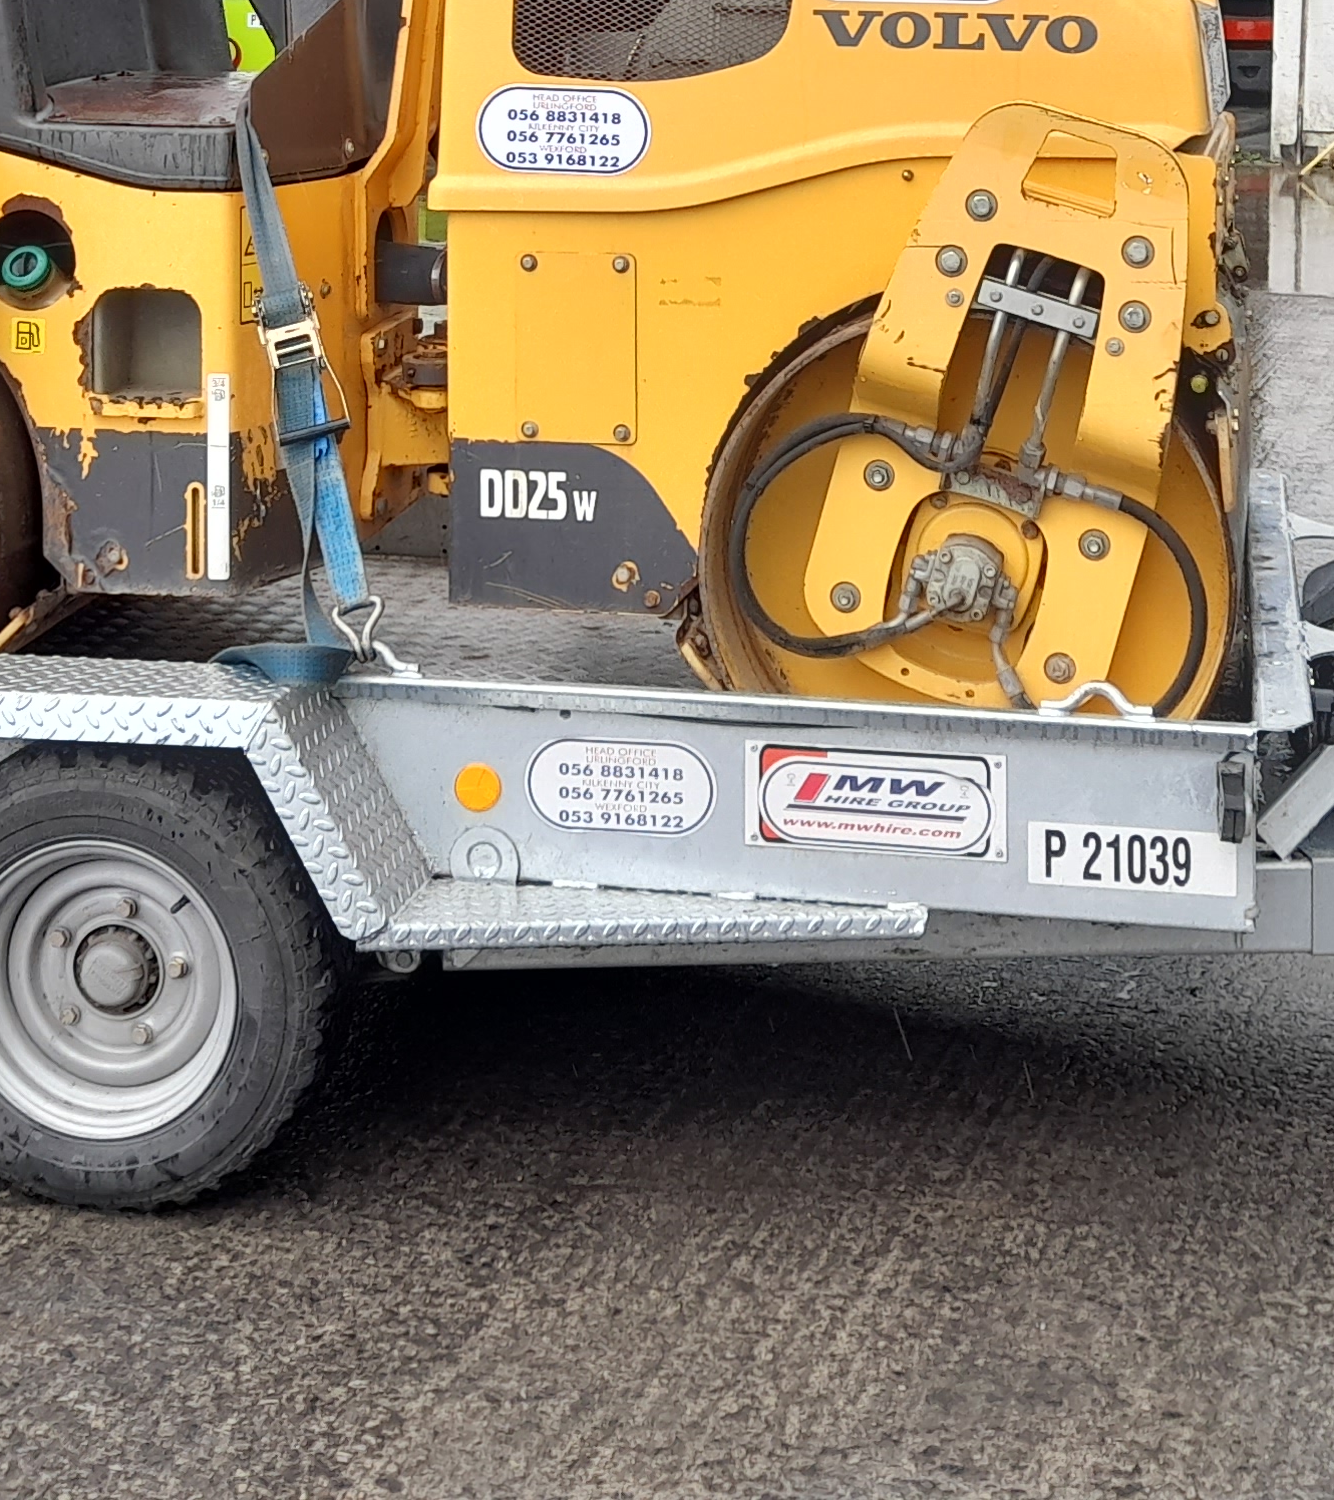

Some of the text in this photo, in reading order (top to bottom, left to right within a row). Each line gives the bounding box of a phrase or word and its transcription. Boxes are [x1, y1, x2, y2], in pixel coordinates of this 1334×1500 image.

[813, 9, 1098, 54] VOLVO
[507, 109, 622, 125] 056 8831418
[507, 130, 621, 146] 056 7761265
[506, 152, 620, 168] 053 9168122
[480, 468, 567, 520] DD25
[585, 746, 657, 758] HEAD OFFICE
[559, 763, 684, 781] 056 8831418
[582, 779, 661, 790] KILKENNY CITY
[832, 774, 946, 797] MW
[559, 786, 684, 804] 056 7761265
[824, 795, 971, 813] HIRE GROUP
[594, 803, 648, 813] WEXFORD
[559, 810, 684, 828] 053 9168122
[782, 817, 962, 840] www.mwhire.com
[1045, 828, 1192, 887] P 21039
